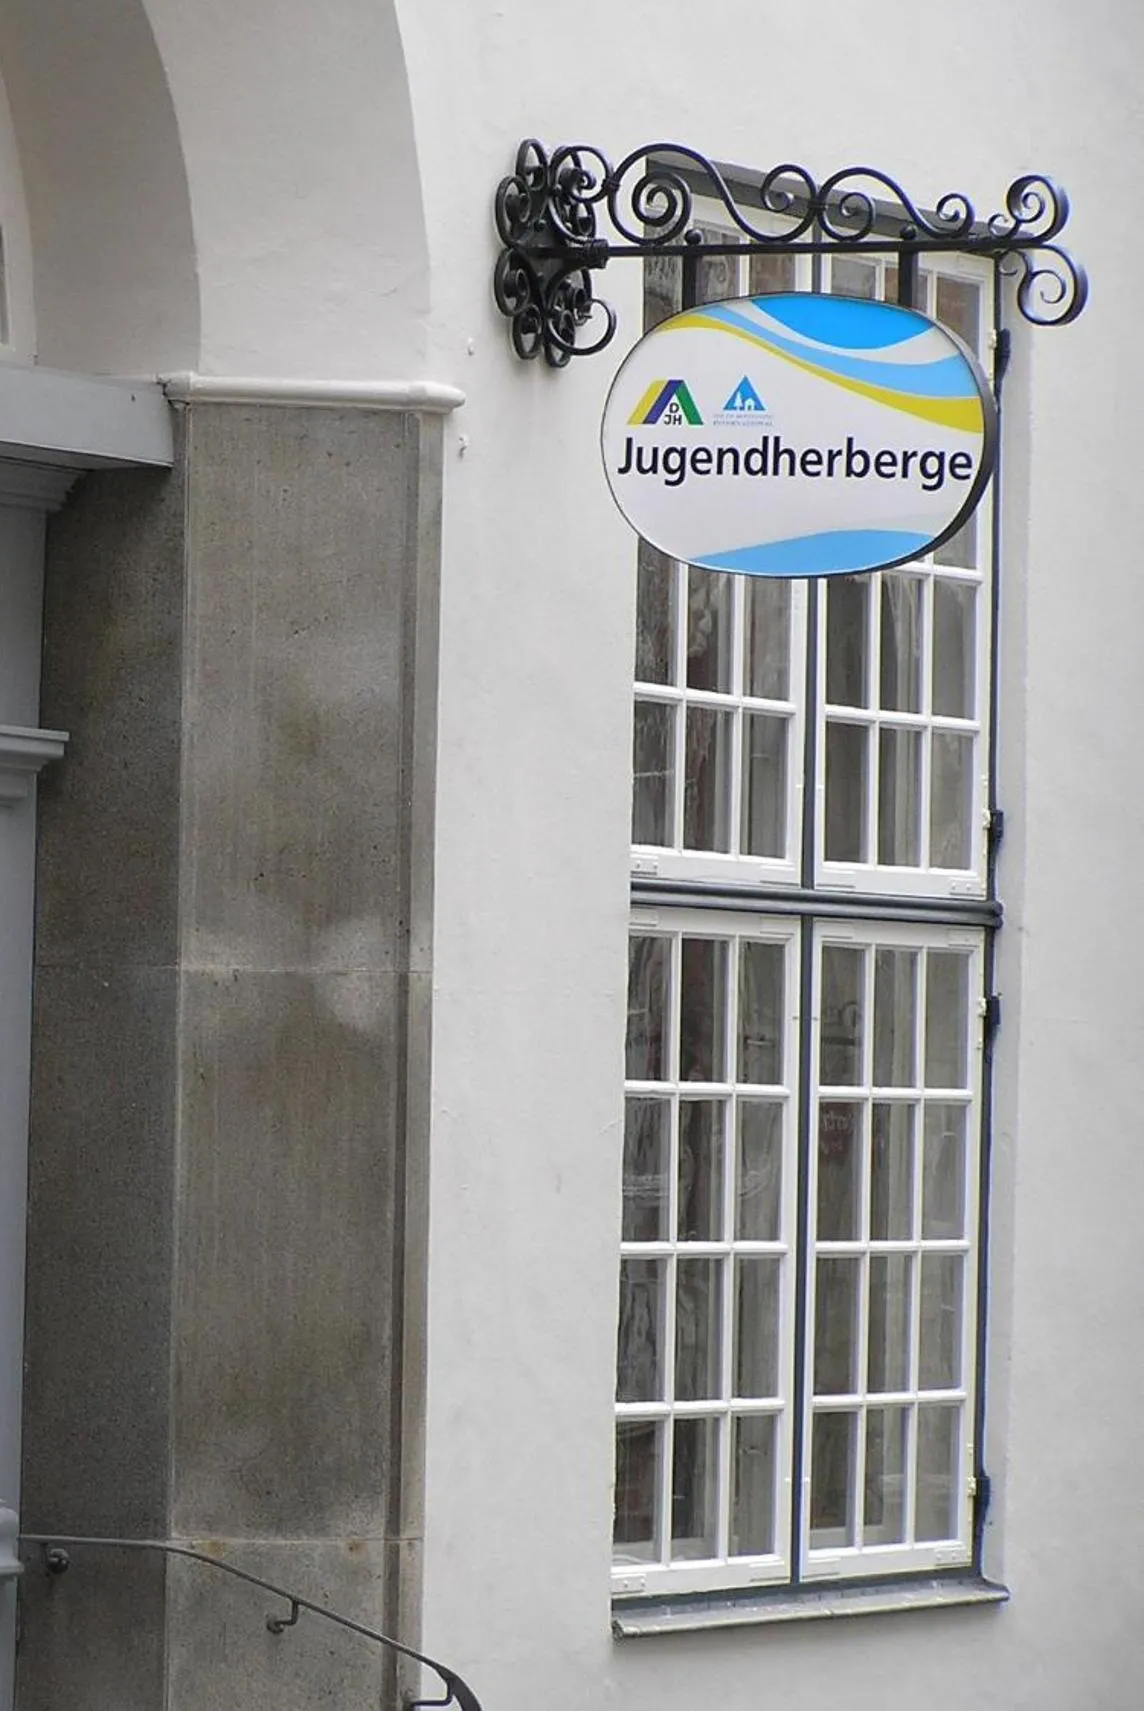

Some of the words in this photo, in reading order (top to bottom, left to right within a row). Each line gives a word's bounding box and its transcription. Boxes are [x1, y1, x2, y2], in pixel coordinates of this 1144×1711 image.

[669, 403, 680, 413] D
[664, 414, 683, 425] JH
[618, 437, 972, 490] Jugendherberge
